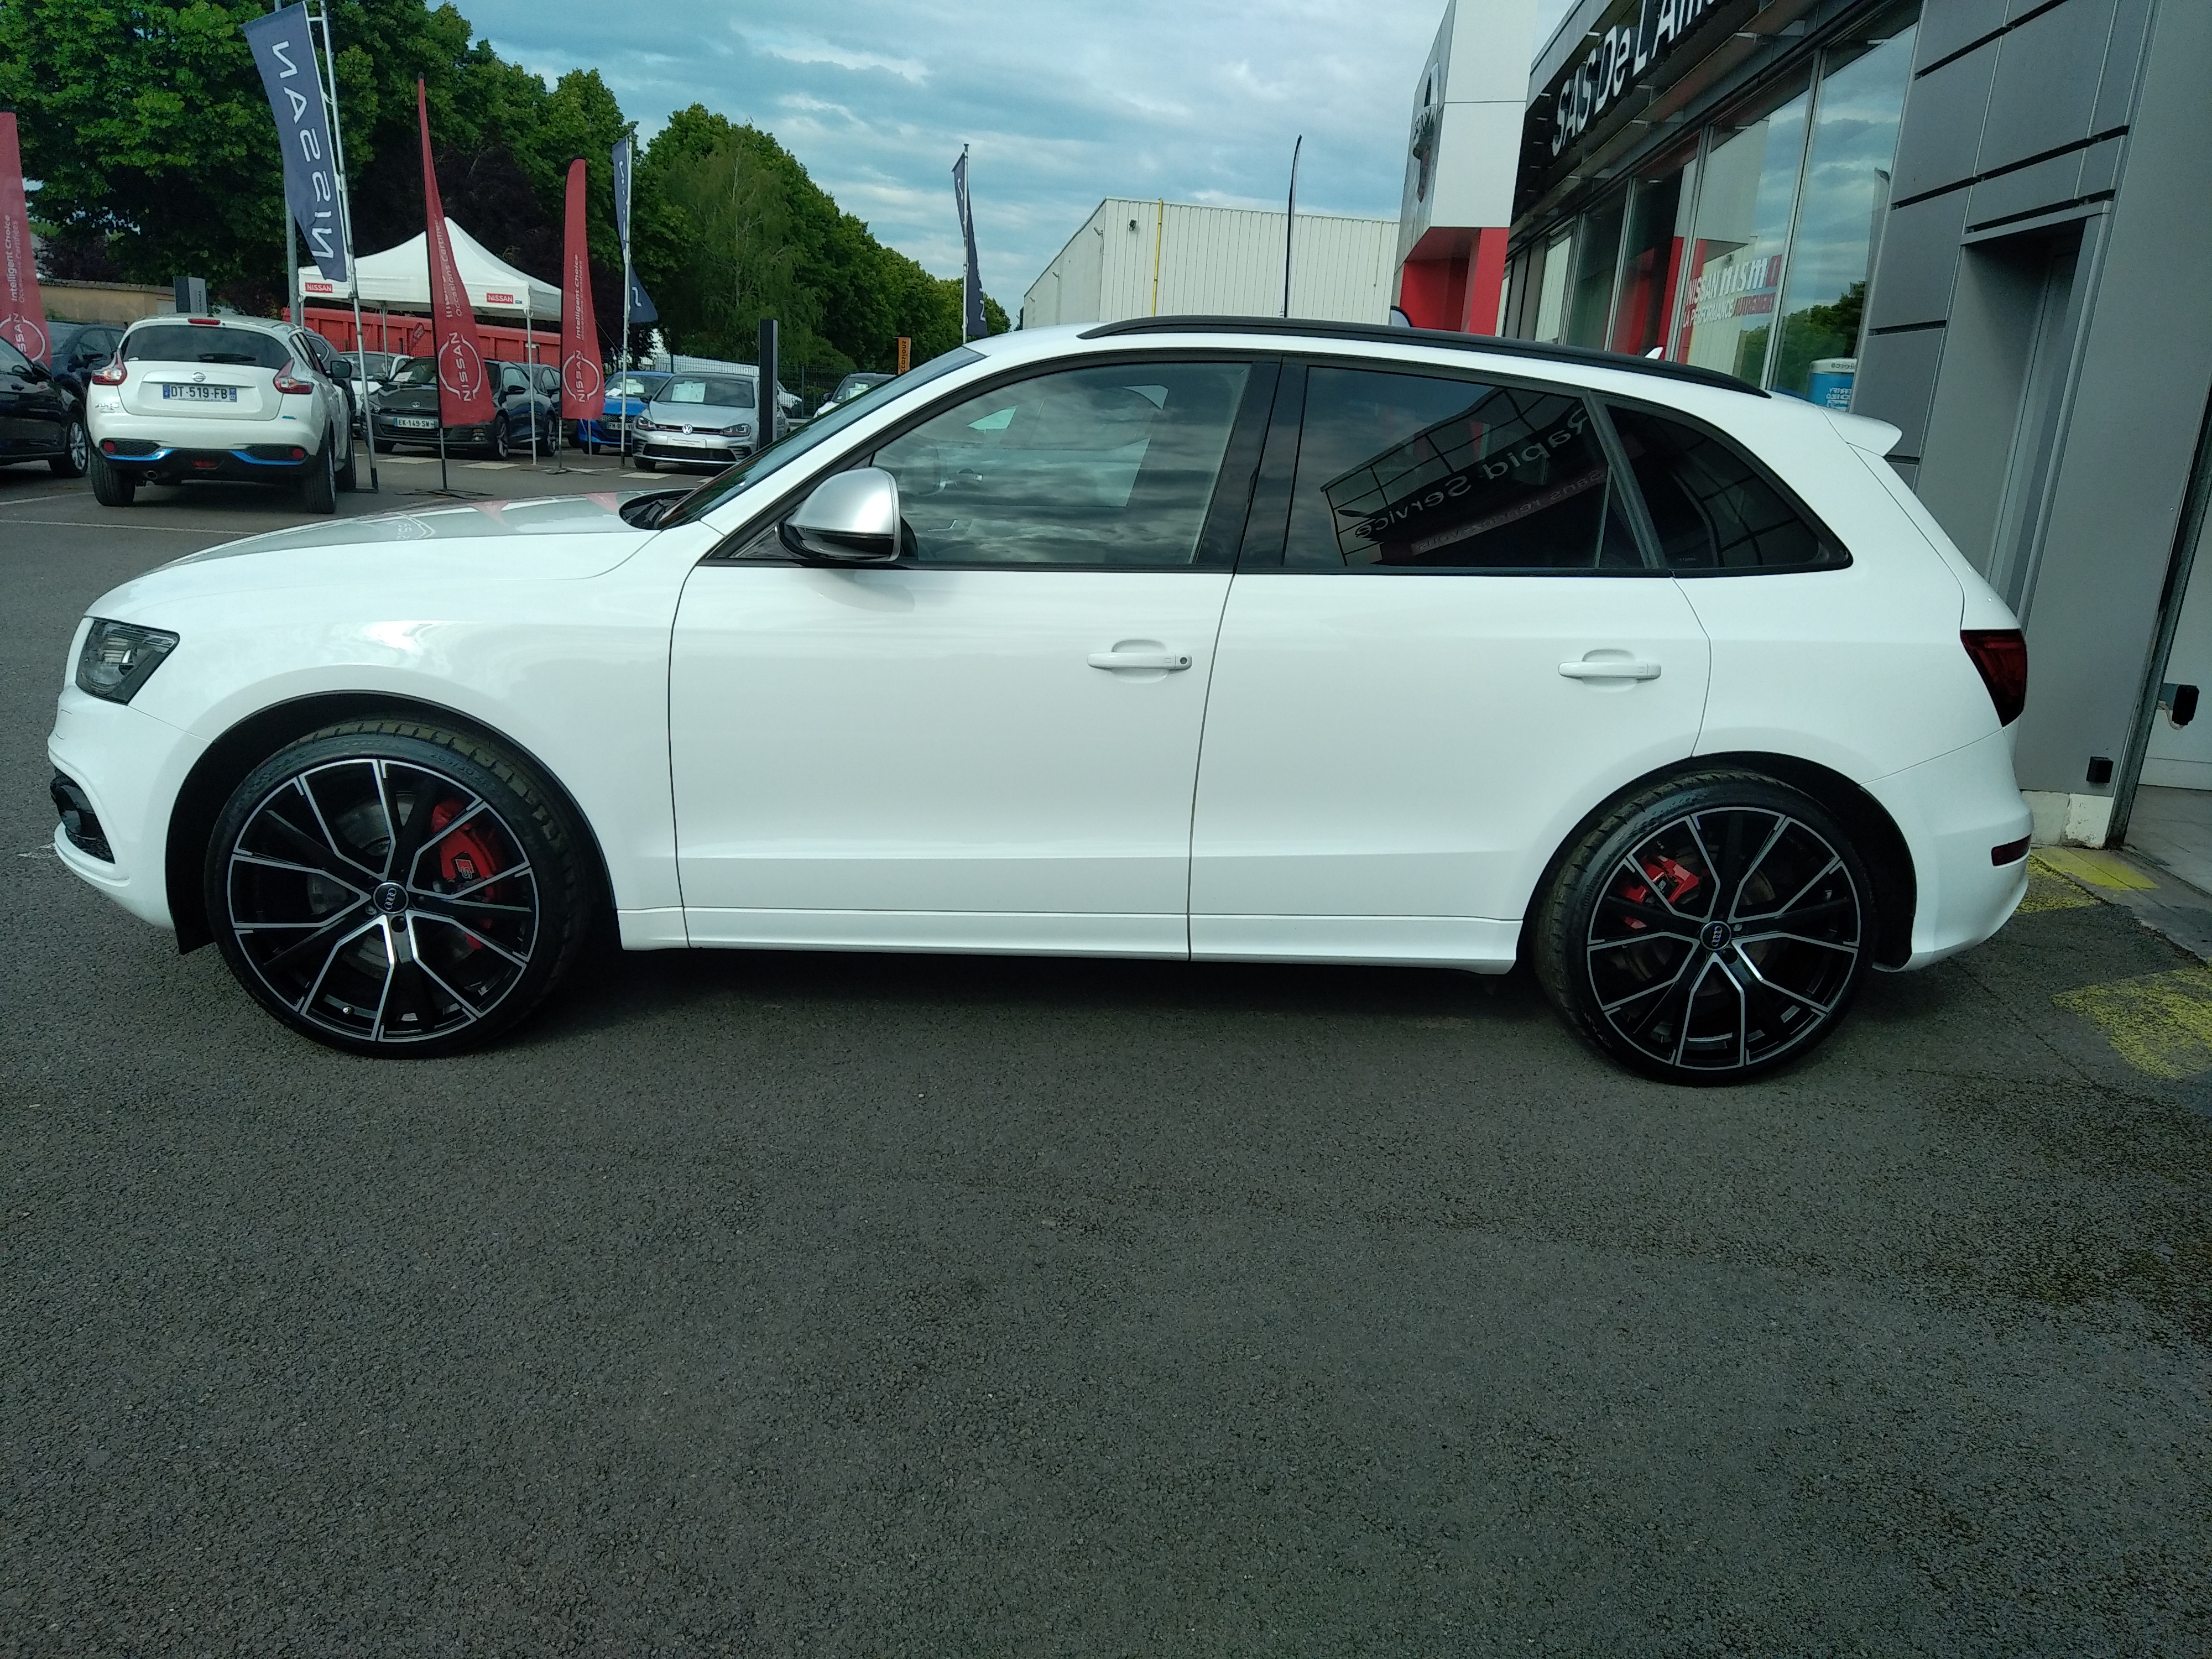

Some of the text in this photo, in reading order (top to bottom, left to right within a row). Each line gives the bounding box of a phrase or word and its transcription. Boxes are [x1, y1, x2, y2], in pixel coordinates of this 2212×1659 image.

[1552, 48, 1597, 156] SAS
[7, 252, 17, 301] Intelligent
[445, 264, 462, 317] Occasions
[488, 294, 513, 302] NISSAN
[1686, 271, 1720, 306] NISSAN
[13, 312, 27, 354] SSAN
[1688, 299, 1735, 327] PERFORMANCE
[448, 332, 472, 402] NISSAN
[575, 350, 586, 403] NISSAN
